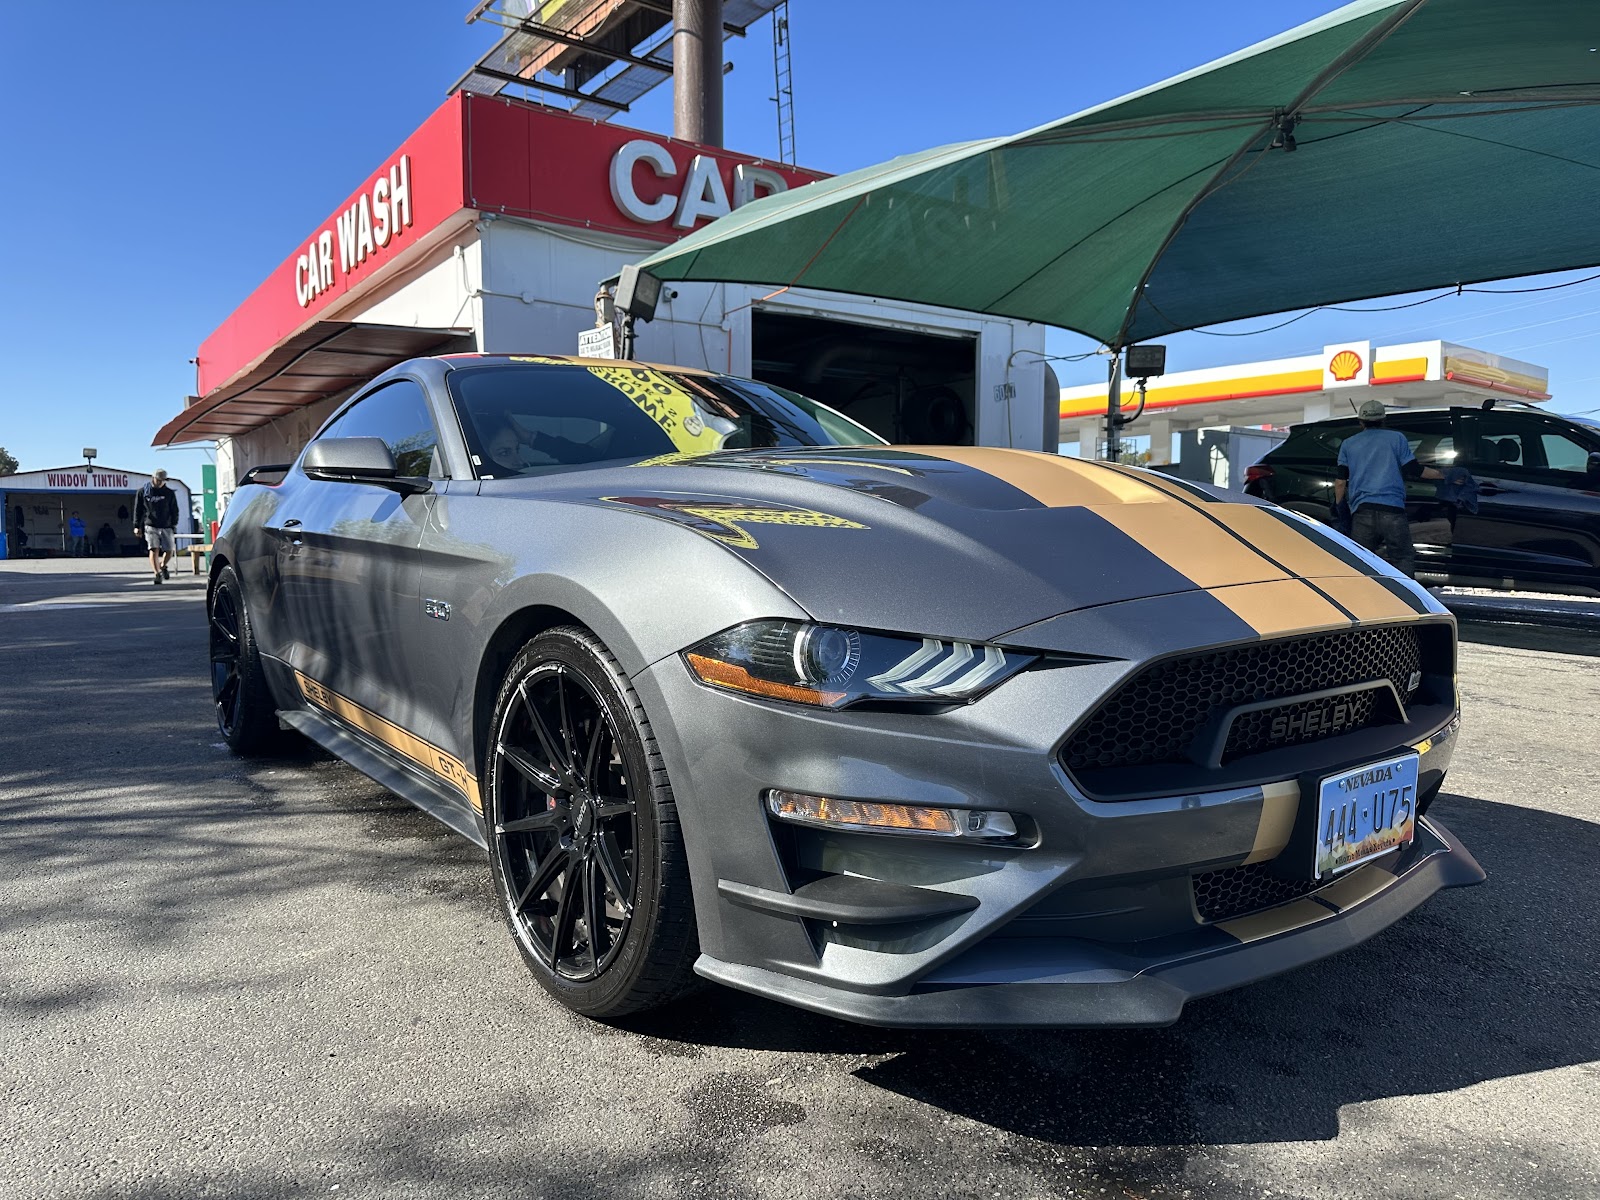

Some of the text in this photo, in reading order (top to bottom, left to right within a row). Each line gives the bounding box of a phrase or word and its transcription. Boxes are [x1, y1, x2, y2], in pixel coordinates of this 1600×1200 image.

[295, 154, 413, 308] CAR WASH
[47, 473, 129, 488] WINDOW TINTING
[1270, 701, 1361, 739] SHELBY
[438, 756, 469, 792] GT-H
[1344, 766, 1393, 793] NEVADA
[1325, 798, 1357, 855] 444
